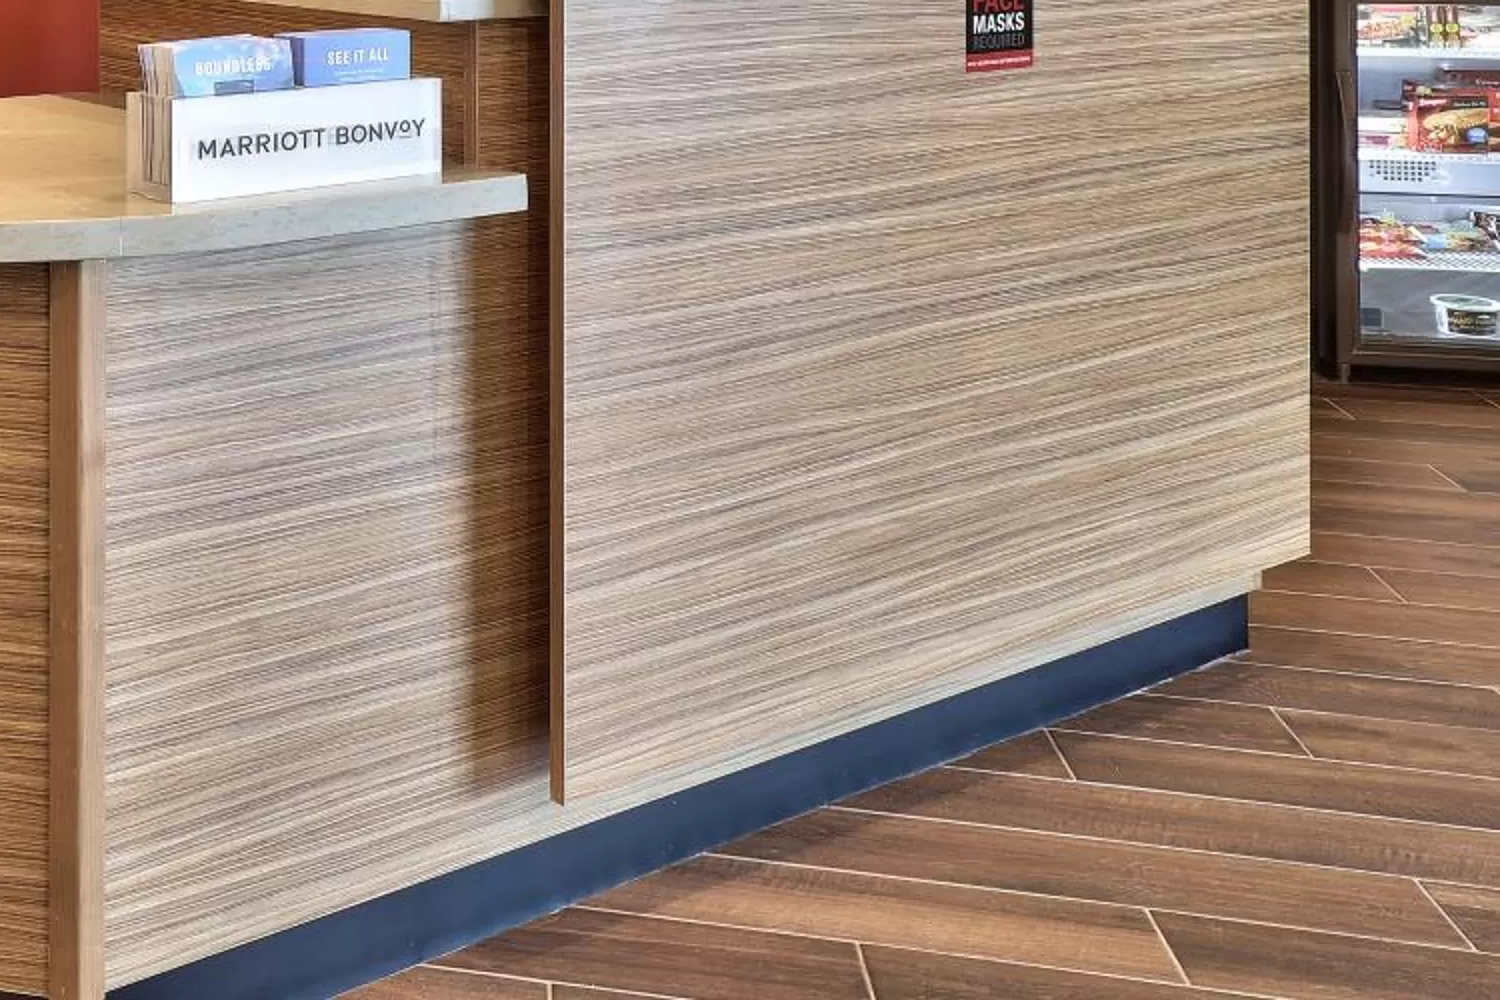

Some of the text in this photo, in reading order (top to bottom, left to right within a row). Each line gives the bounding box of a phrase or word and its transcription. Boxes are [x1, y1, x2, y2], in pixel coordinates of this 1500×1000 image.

[973, 11, 1026, 35] MASKS
[327, 47, 389, 66] SEE IT ALL
[197, 117, 426, 161] MARRIOTT BONVOY
